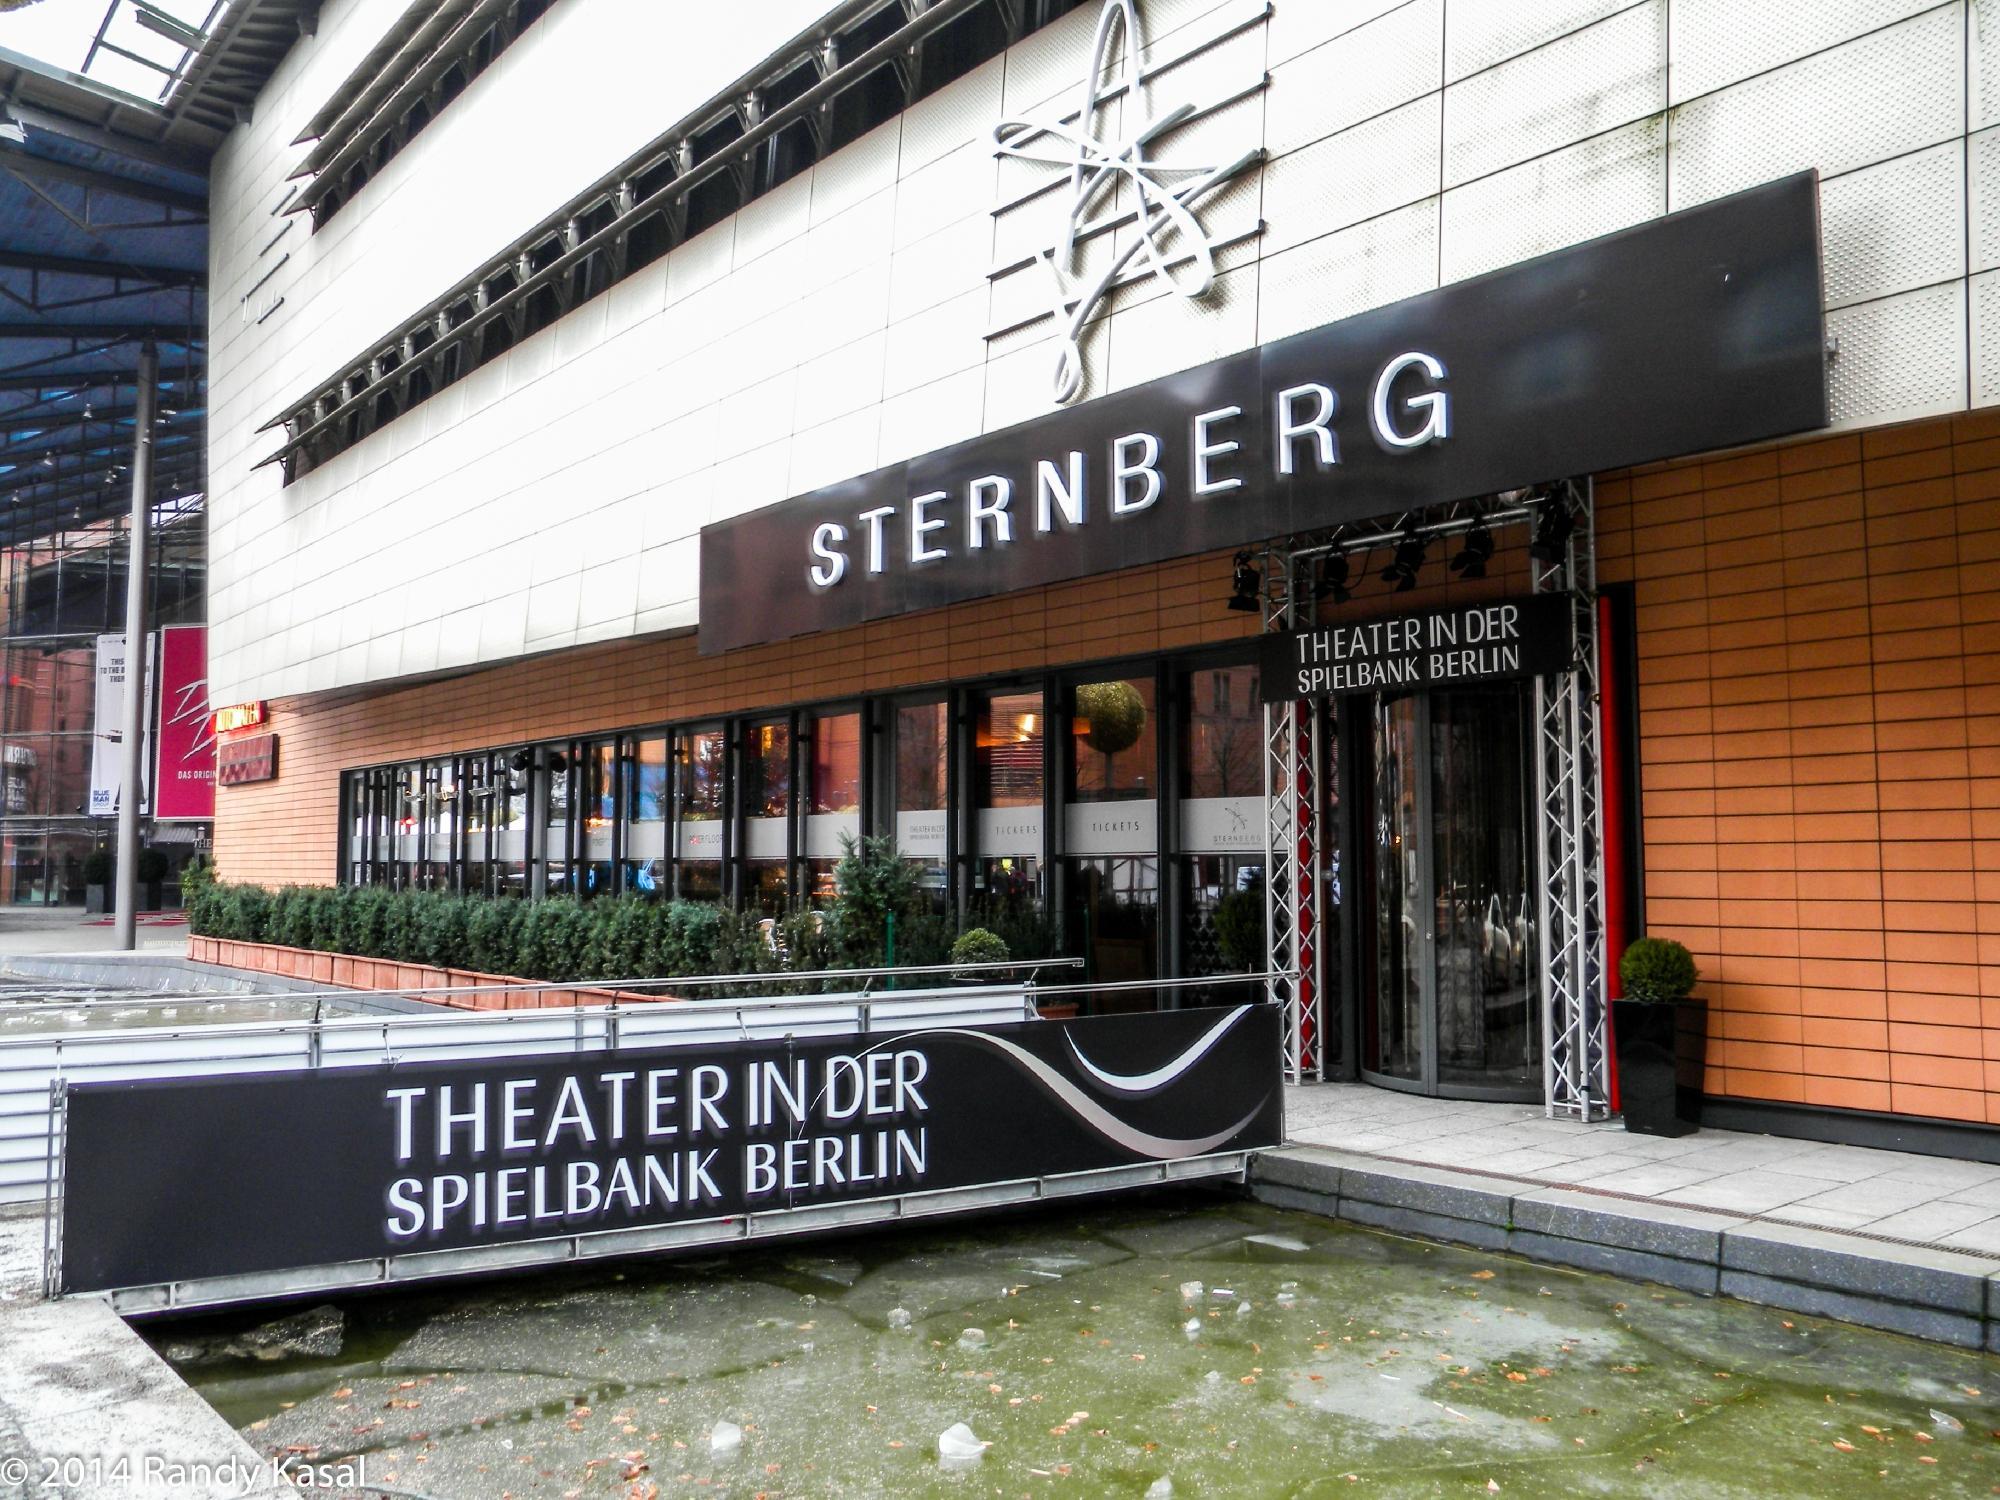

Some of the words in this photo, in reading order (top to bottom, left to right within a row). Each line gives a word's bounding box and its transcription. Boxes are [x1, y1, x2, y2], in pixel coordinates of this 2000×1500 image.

[809, 352, 1448, 587] STERNBERG
[1296, 618, 1422, 663] THEATER
[1428, 613, 1457, 648] IN
[1465, 605, 1519, 643] DER
[1298, 656, 1420, 694] SPIELBANK
[1430, 644, 1519, 680] BERLIN
[178, 770, 192, 779] DAS
[996, 825, 1038, 835] TICKETS
[1092, 821, 1140, 832] TICKETS
[387, 1064, 729, 1161] THEATER
[747, 1059, 805, 1128] IN
[826, 1050, 929, 1120] DER
[387, 1148, 722, 1237] SPIELBANK
[746, 1126, 927, 1195] BERLIN
